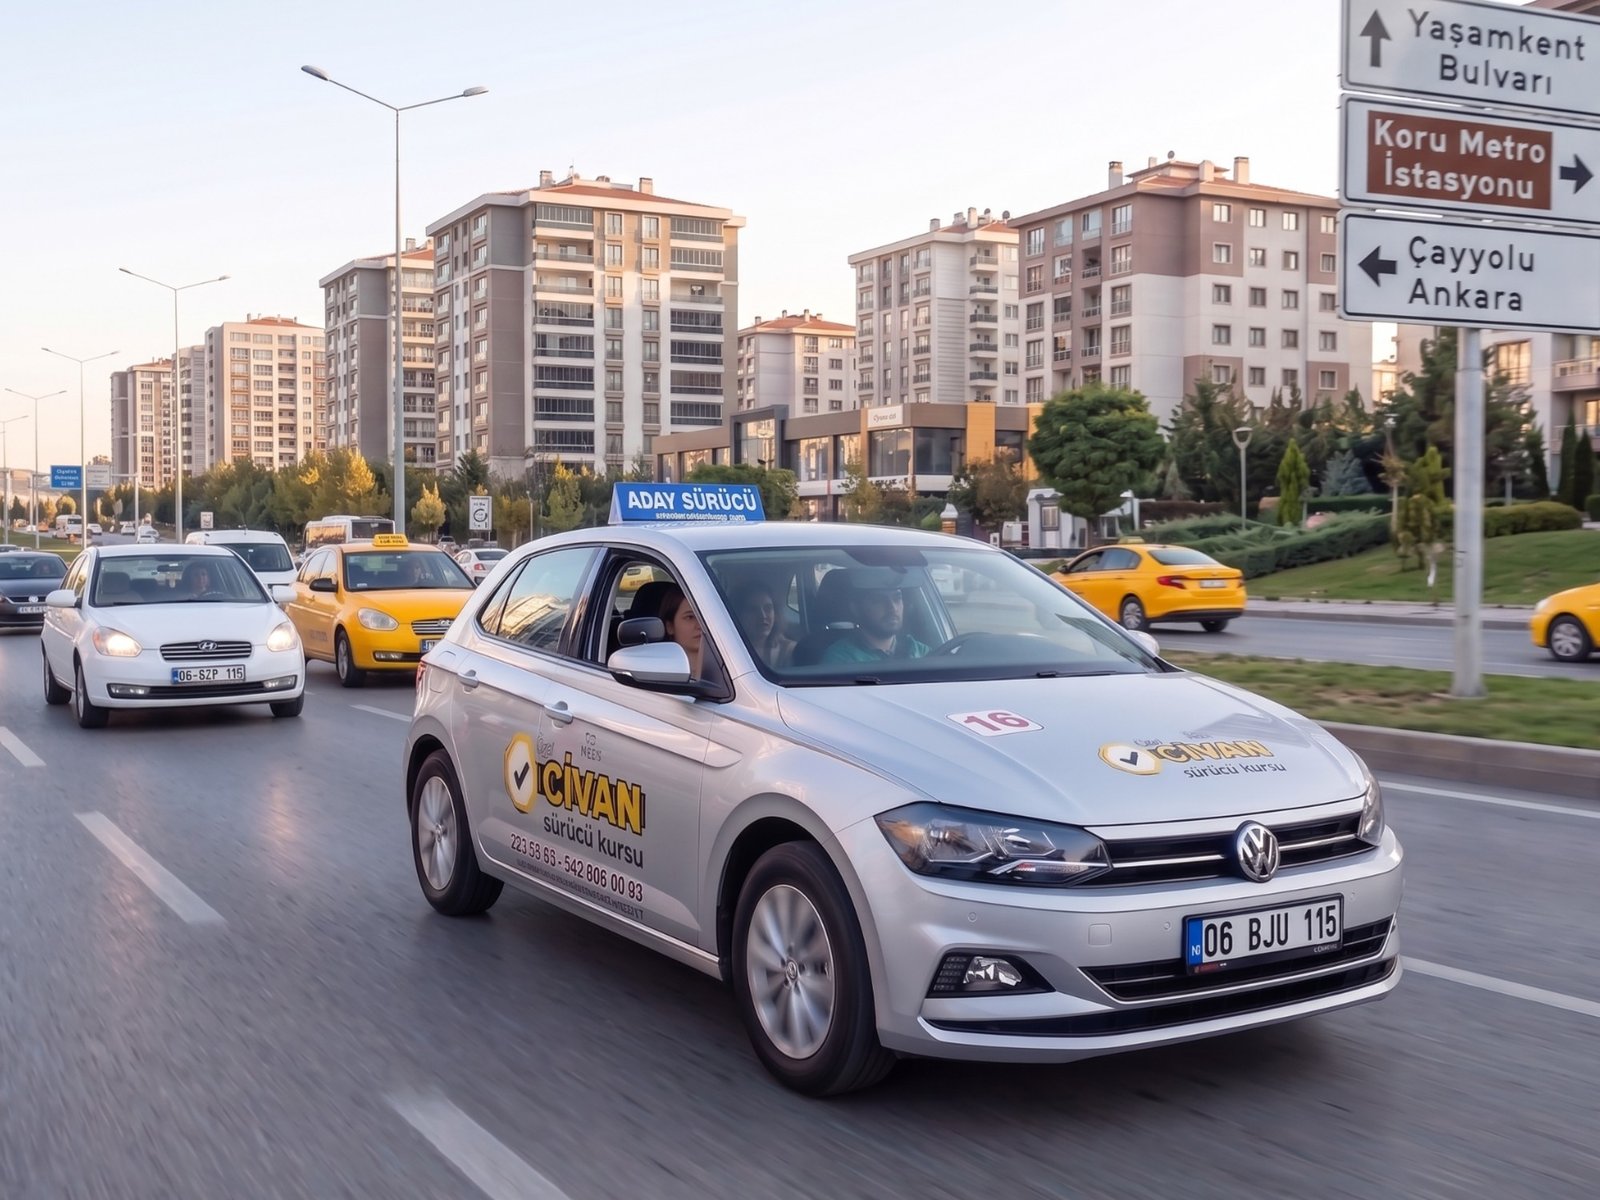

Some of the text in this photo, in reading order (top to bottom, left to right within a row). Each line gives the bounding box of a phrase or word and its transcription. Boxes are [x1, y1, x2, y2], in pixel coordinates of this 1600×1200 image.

[1408, 8, 1586, 61] Yaşamkent
[1440, 53, 1552, 95] Bulvarı
[1374, 118, 1546, 164] Koru Metro
[1385, 150, 1534, 200] İstasyonu
[1408, 235, 1535, 275] Çayyolu
[1408, 278, 1523, 312] Ankara
[628, 487, 757, 511] ADAY SÜRÜCÜ
[226, 668, 243, 679] 115
[963, 711, 1031, 732] 16
[1155, 740, 1275, 763] CİVAN
[1184, 763, 1287, 779] sürücü kursu
[541, 752, 645, 836] CİVAN
[543, 812, 644, 869] sürücü kursu
[564, 855, 584, 879] 542
[586, 864, 607, 888] 806
[610, 873, 625, 895] 00
[628, 880, 643, 902] 93
[1204, 905, 1337, 957] 06 BJU 115
